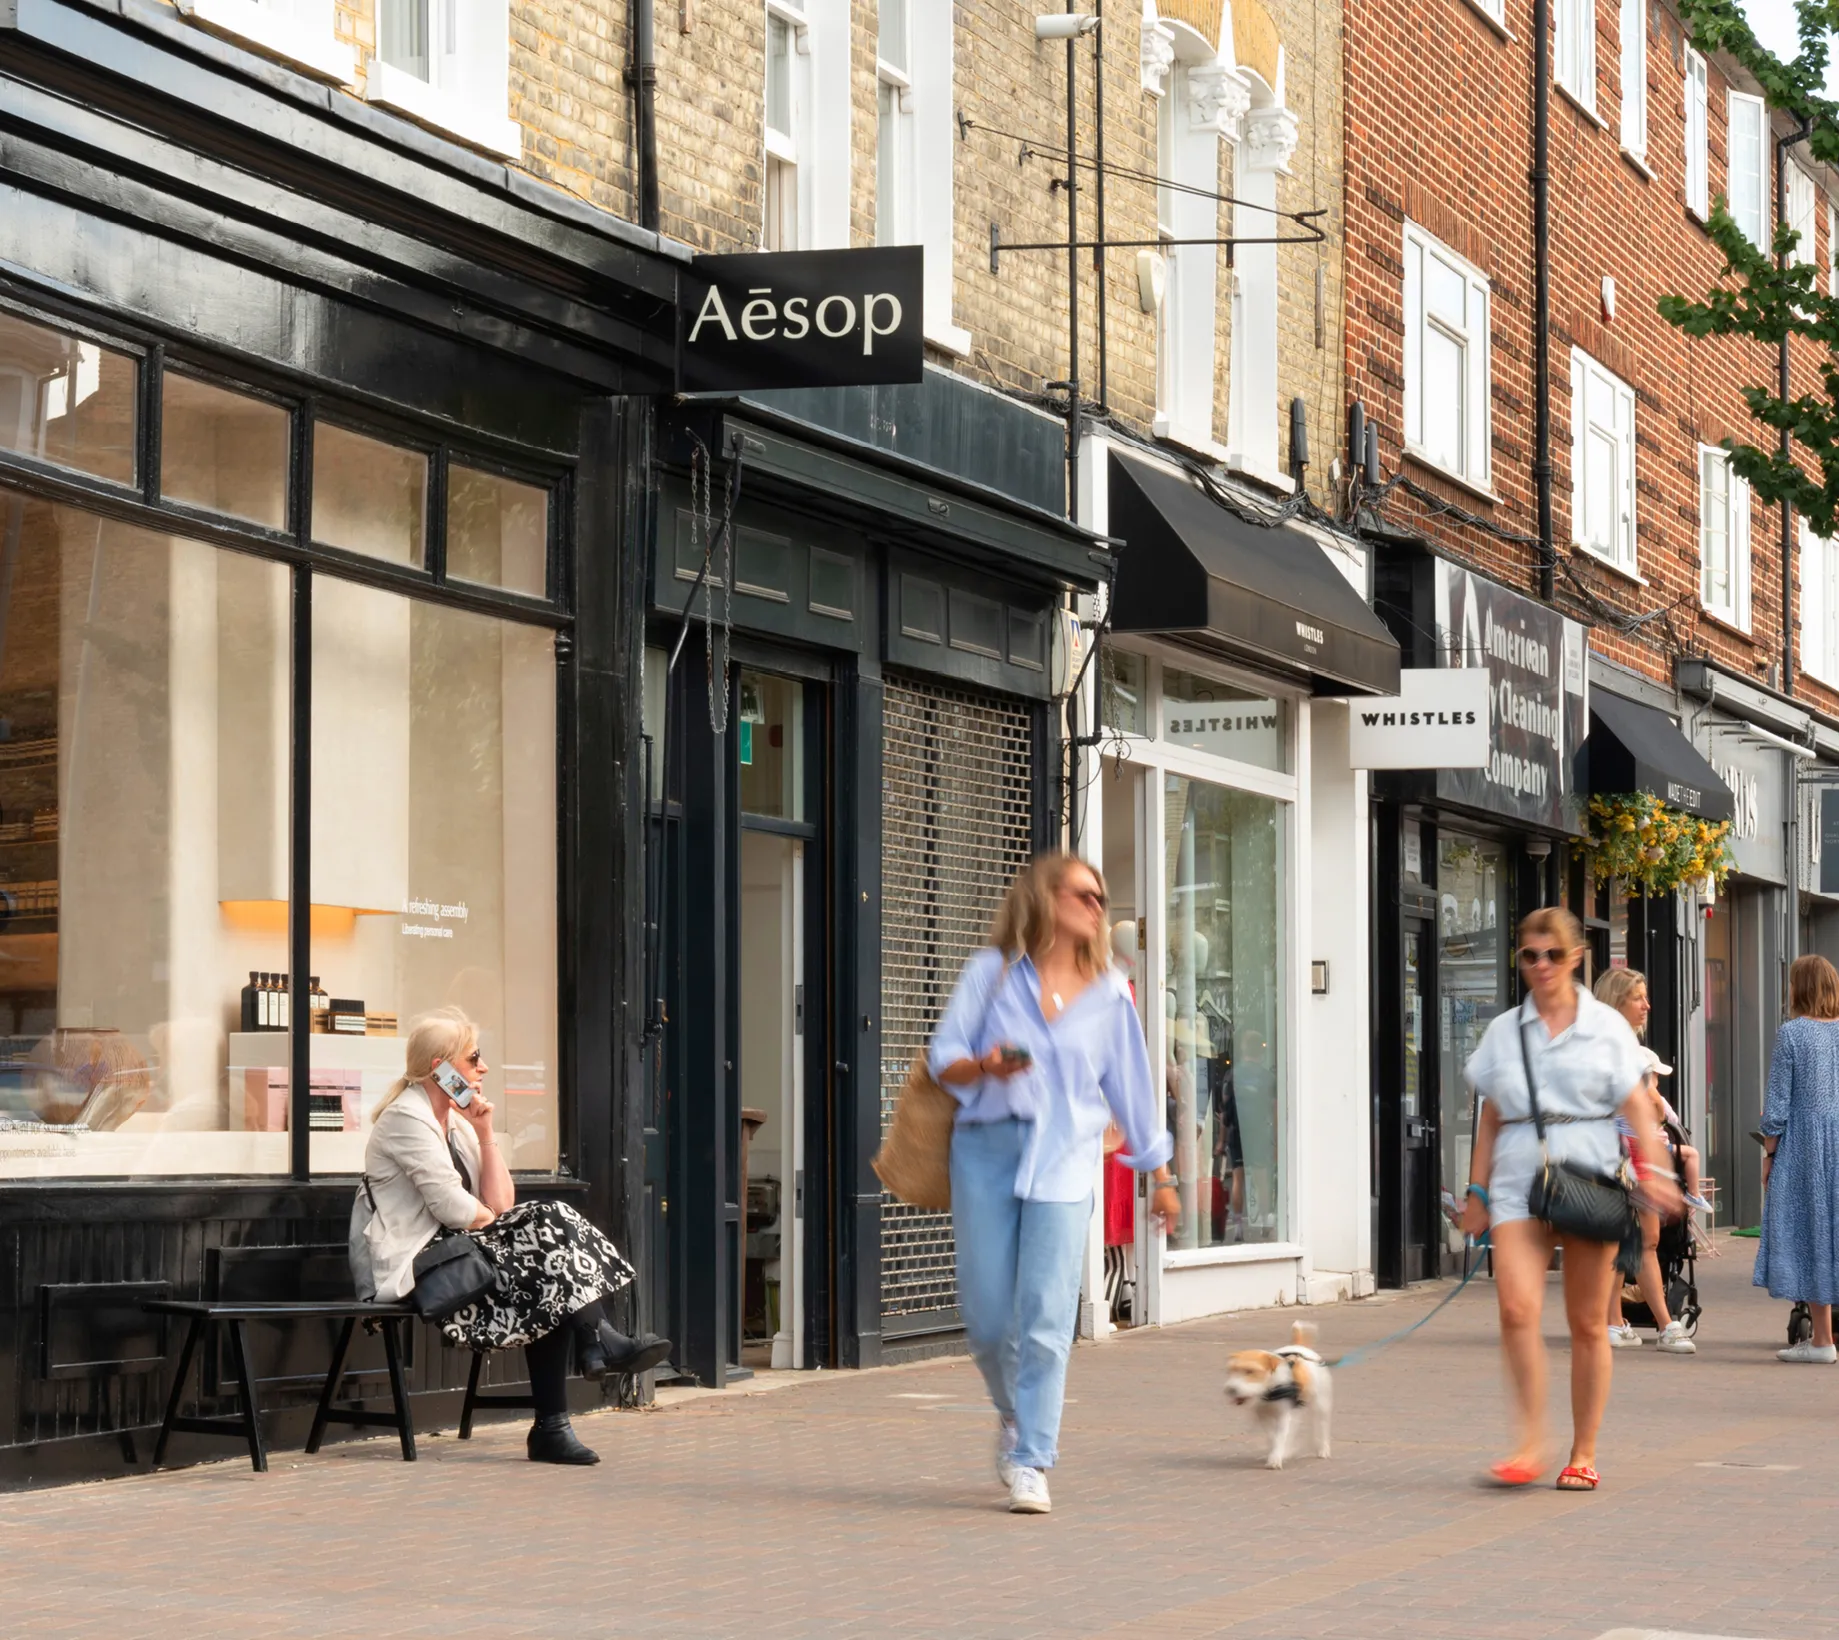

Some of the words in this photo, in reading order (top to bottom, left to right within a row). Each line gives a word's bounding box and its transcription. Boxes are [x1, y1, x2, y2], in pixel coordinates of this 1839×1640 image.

[688, 284, 902, 355] Aēsop
[1296, 620, 1324, 645] WHISTLES
[1484, 606, 1549, 678] American
[1361, 711, 1476, 727] WHISTLES
[1500, 678, 1560, 751] Cleaning
[440, 900, 469, 925] assembly
